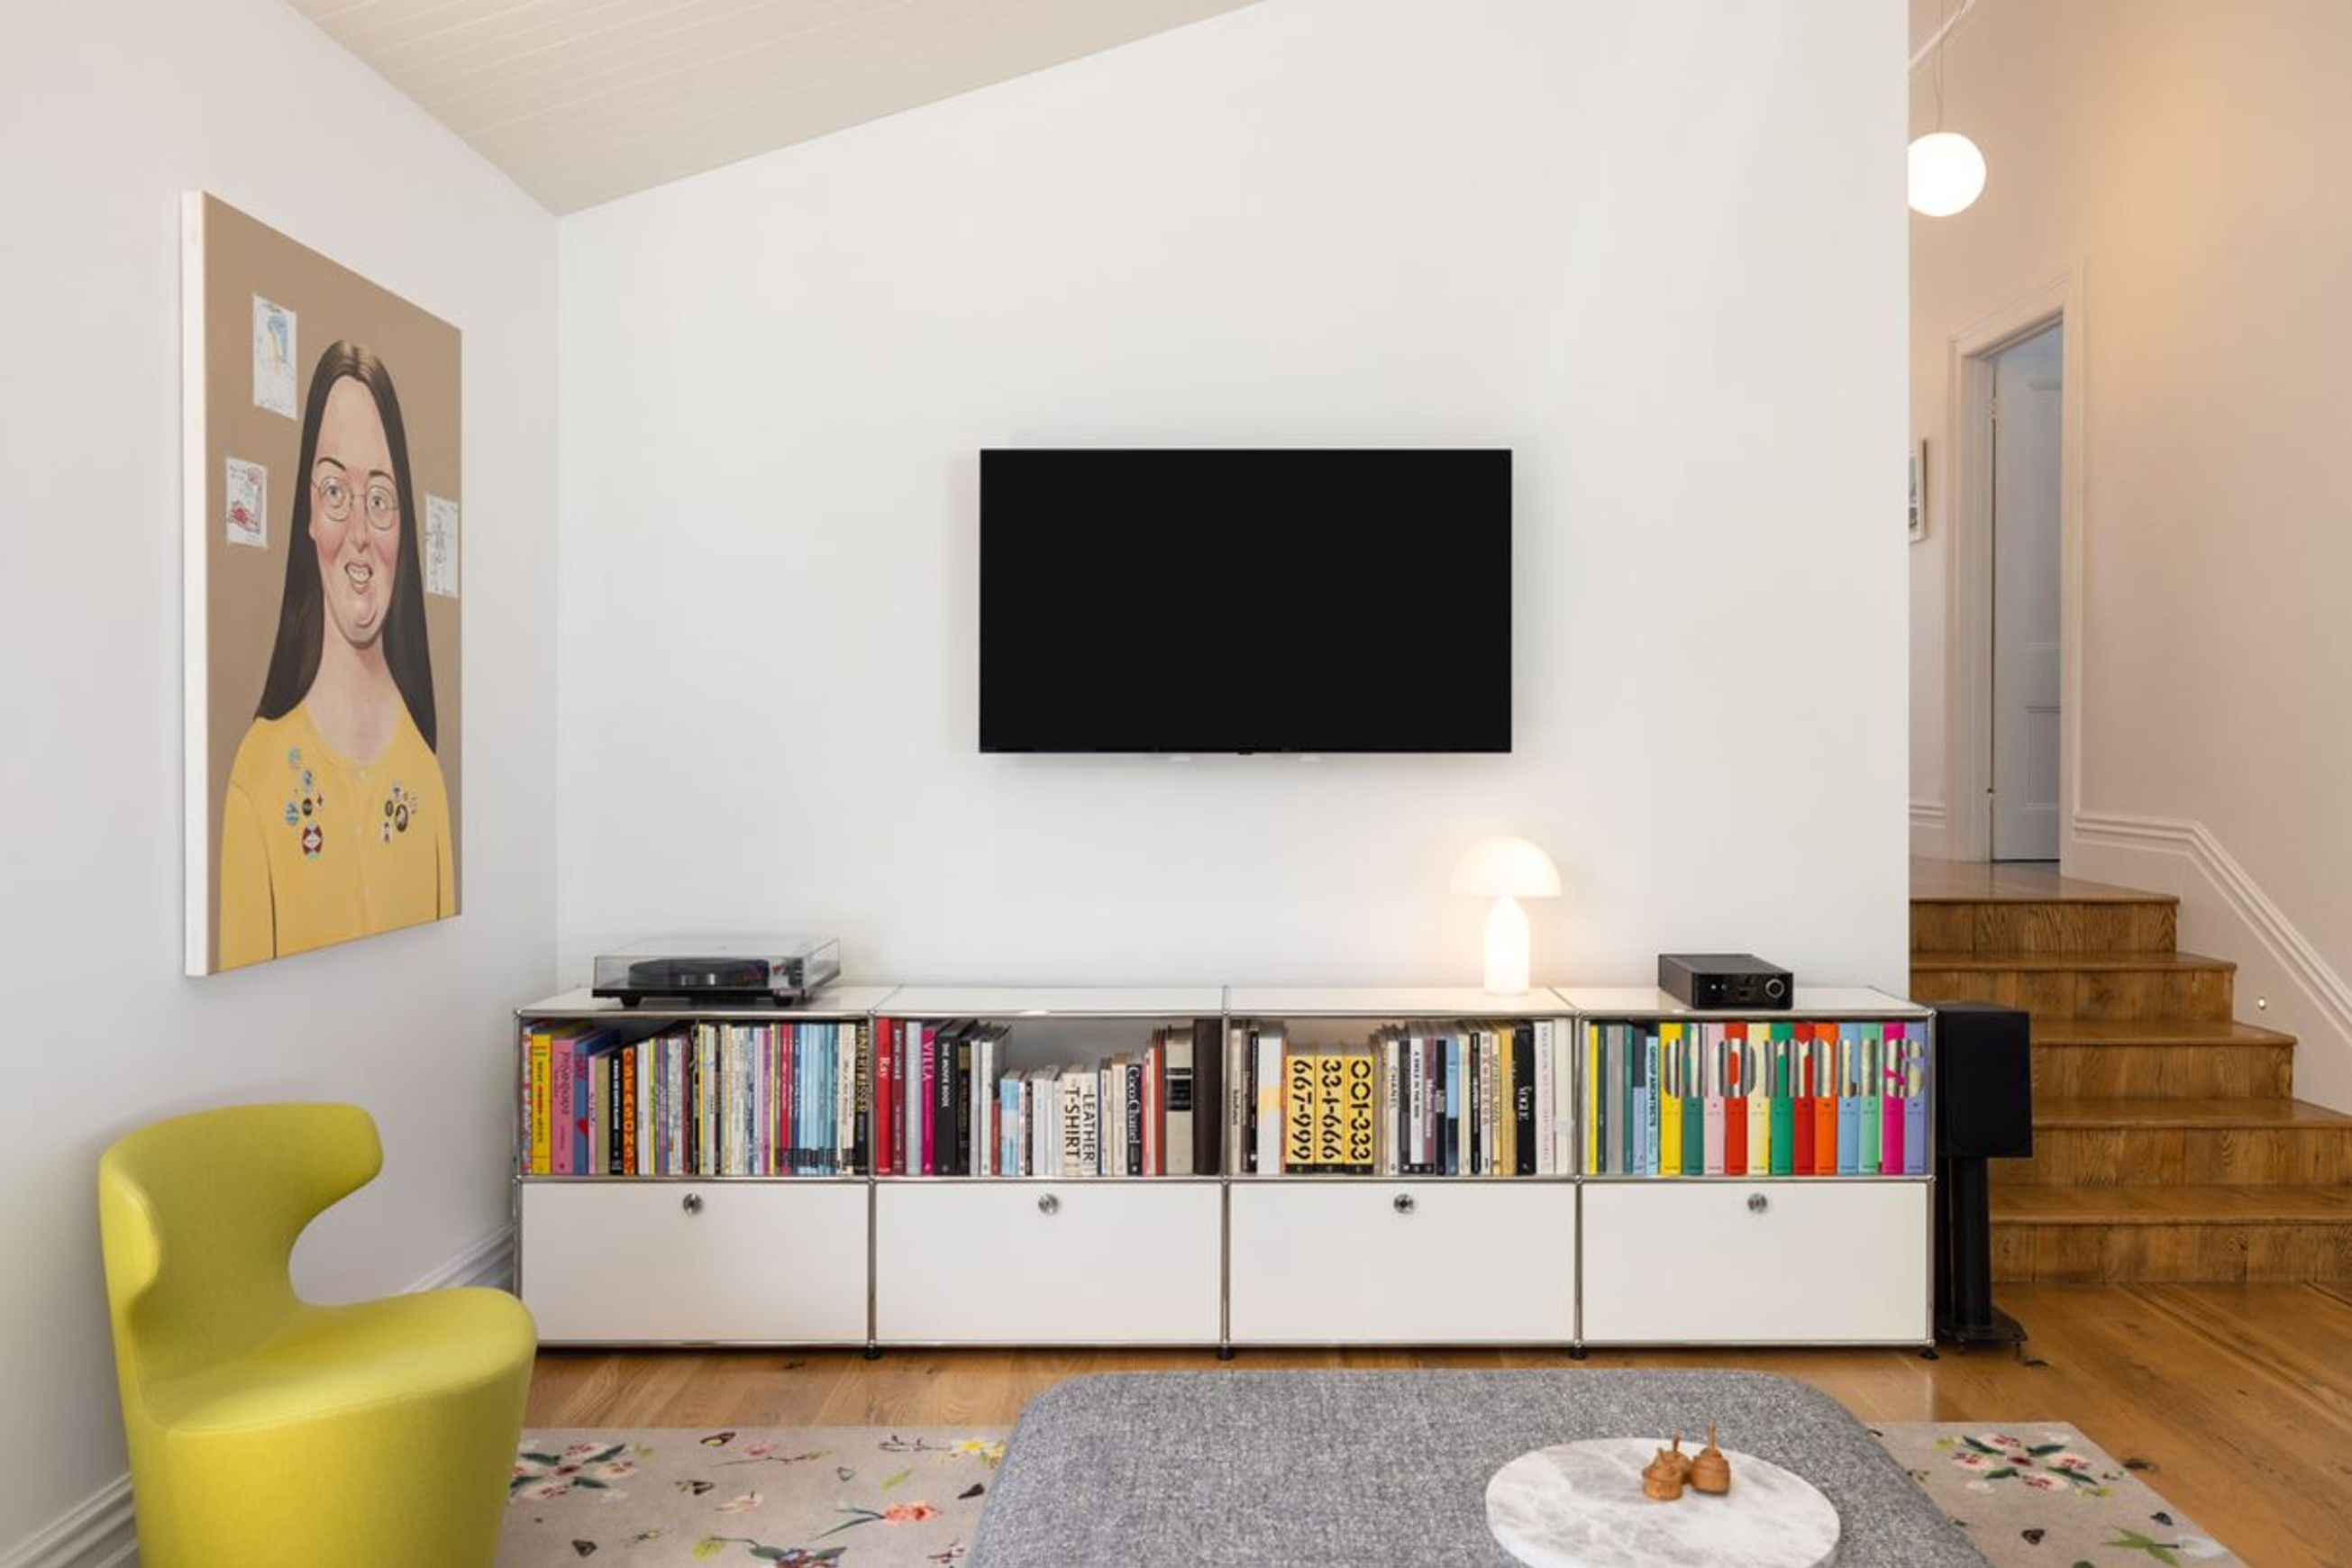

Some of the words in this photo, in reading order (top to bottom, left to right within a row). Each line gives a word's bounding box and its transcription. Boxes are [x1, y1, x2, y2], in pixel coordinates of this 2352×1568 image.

[878, 1057, 891, 1079] Ray
[923, 1041, 934, 1081] VILLA
[941, 1043, 951, 1056] THE
[1649, 1046, 1658, 1075] GROUP
[1664, 1024, 1924, 1099] domus
[941, 1059, 951, 1083] MOVIE
[1126, 1066, 1140, 1099] Coco
[1389, 1067, 1398, 1109] CHANEL
[941, 1085, 951, 1108] BOOK
[1292, 1059, 1313, 1160] 667-999
[1321, 1059, 1342, 1160] 334-666
[1351, 1060, 1371, 1160] 001-333
[1518, 1086, 1532, 1121] VOGUE
[1649, 1077, 1658, 1127] ARCHITECTS
[1065, 1087, 1080, 1159] T-SHIRT
[1082, 1093, 1095, 1162] LEATHER
[1126, 1099, 1142, 1144] Chanel
